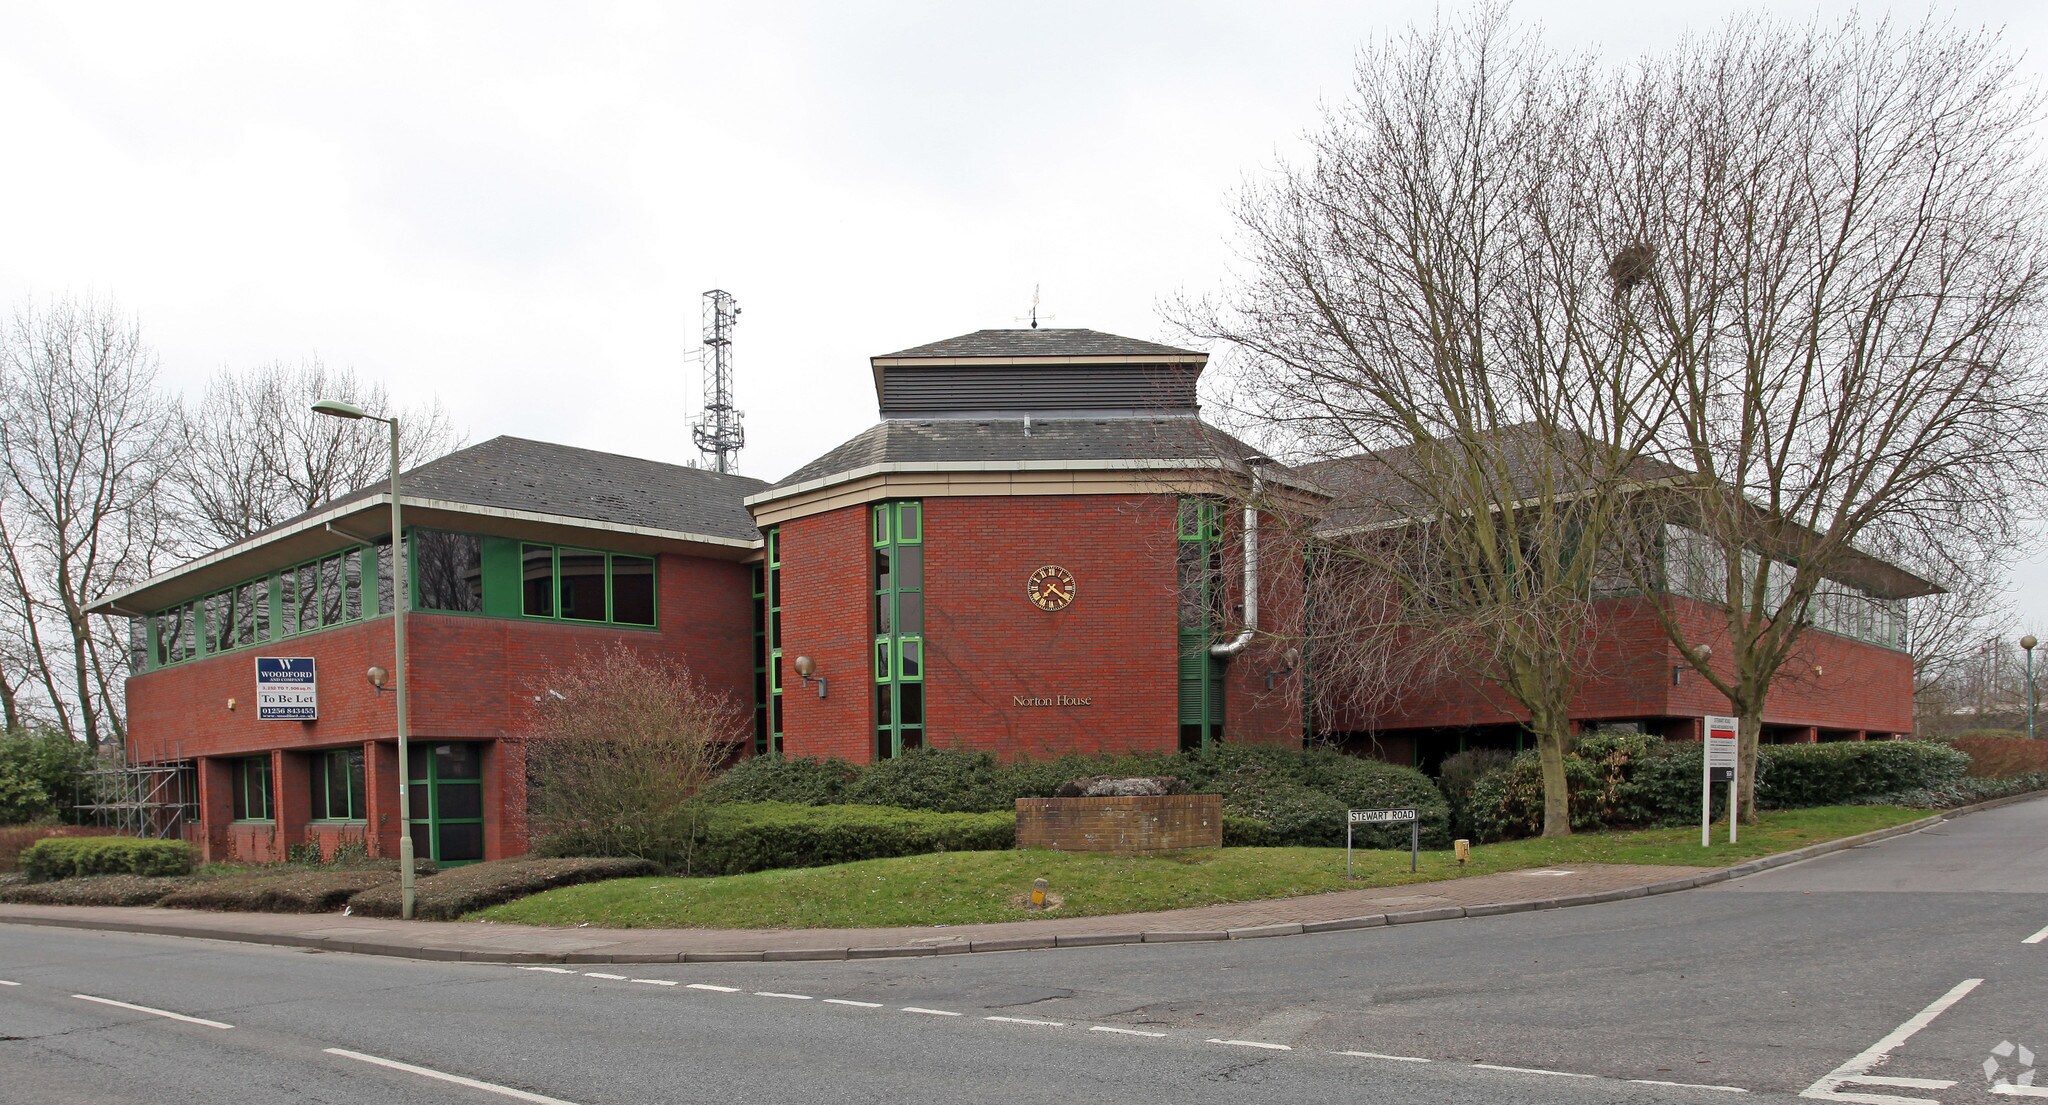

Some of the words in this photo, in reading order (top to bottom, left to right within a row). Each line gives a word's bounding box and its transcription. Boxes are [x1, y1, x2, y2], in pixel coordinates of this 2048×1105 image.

[262, 695, 275, 703] To
[278, 695, 293, 703] Be
[296, 695, 314, 703] Let
[1013, 695, 1053, 707] Norton
[1057, 694, 1092, 706] House
[1351, 811, 1389, 821] STEWART
[1392, 810, 1414, 820] ROAD
